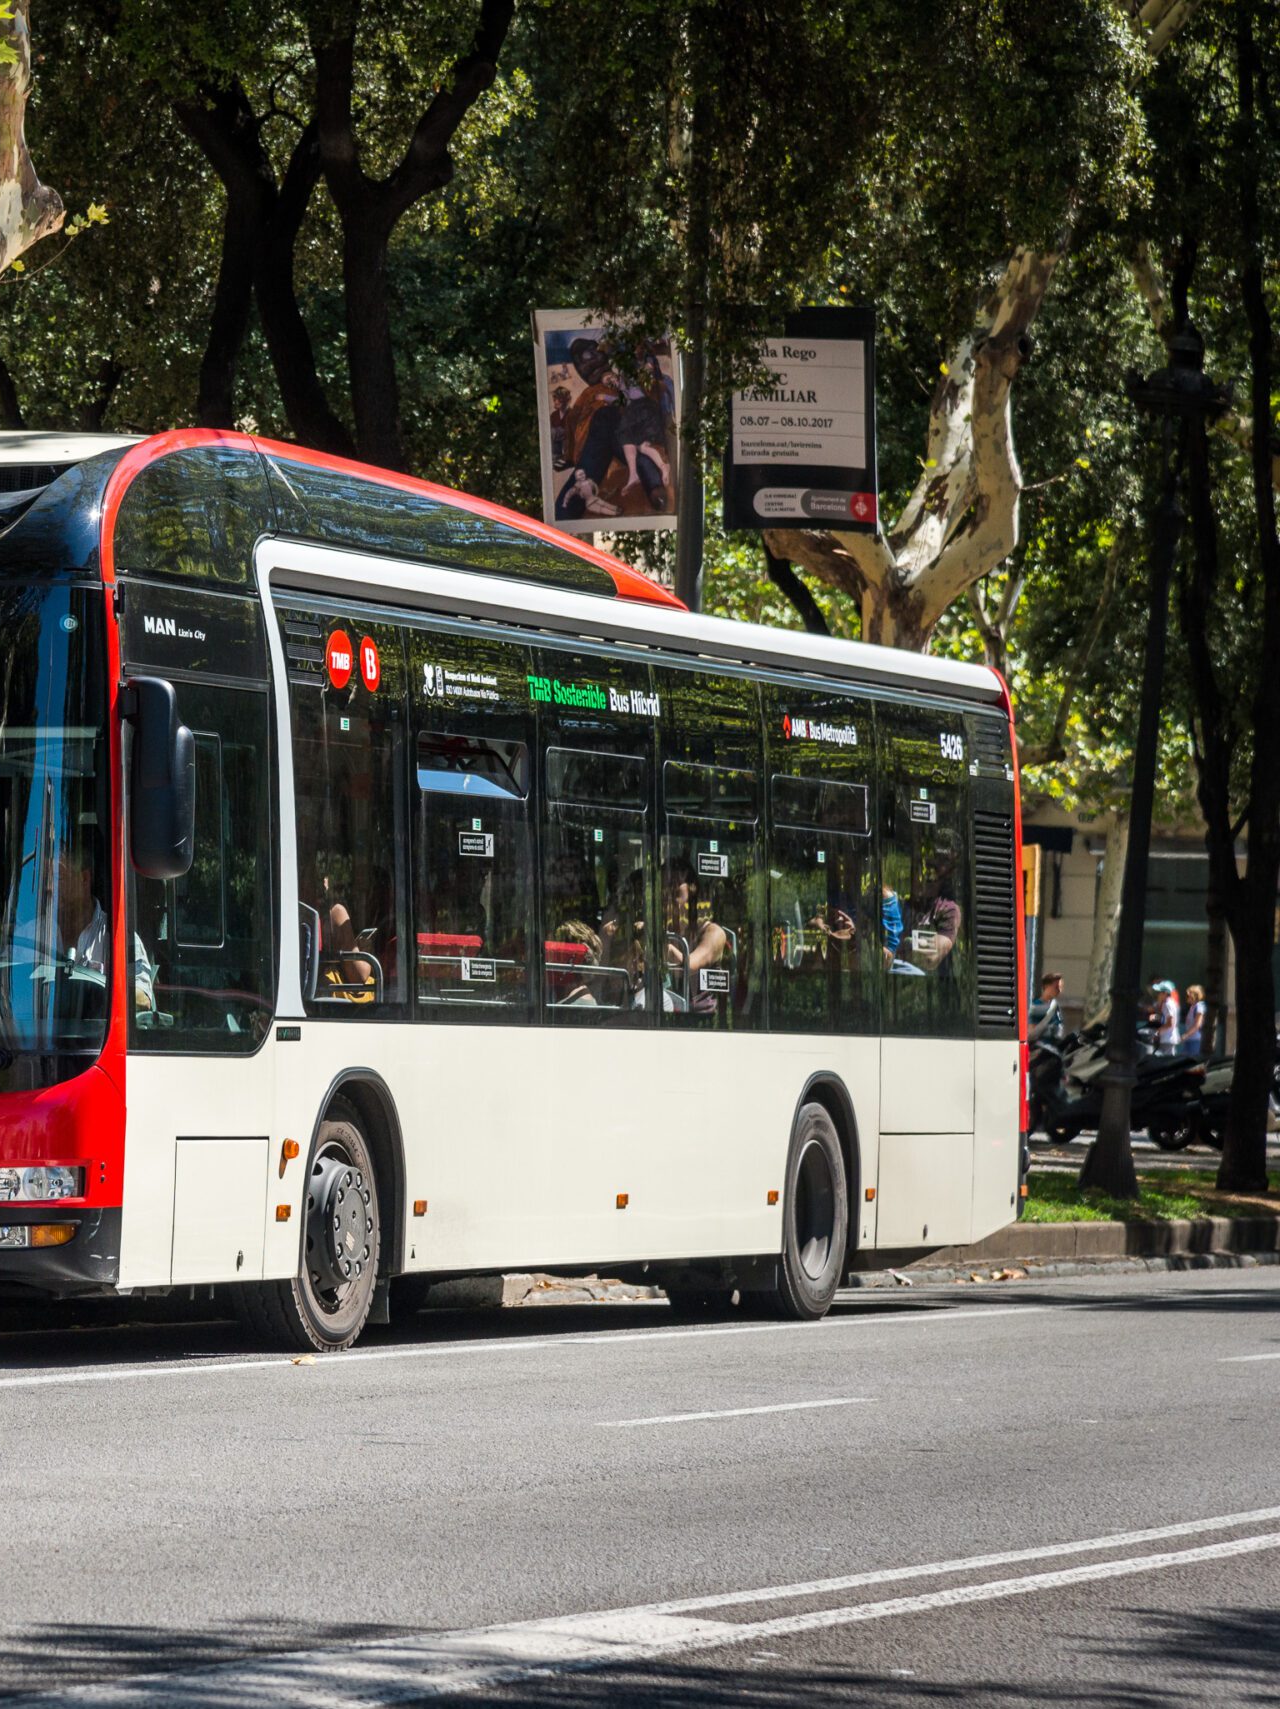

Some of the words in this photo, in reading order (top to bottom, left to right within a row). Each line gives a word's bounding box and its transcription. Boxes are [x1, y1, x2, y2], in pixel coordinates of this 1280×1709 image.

[783, 346, 816, 361] Rego
[740, 416, 770, 427] 08.07
[780, 417, 833, 428] 08.10.2017
[810, 502, 846, 512] Barcelona
[144, 615, 176, 636] MAN
[194, 630, 206, 641] City
[331, 651, 350, 670] TMB
[527, 675, 552, 702] TMB
[554, 680, 606, 709] Sostenible
[609, 687, 629, 712] Bus
[791, 718, 806, 737] AMB
[809, 720, 820, 740] Bus
[820, 722, 858, 747] Metropolità
[940, 733, 963, 760] 5426
